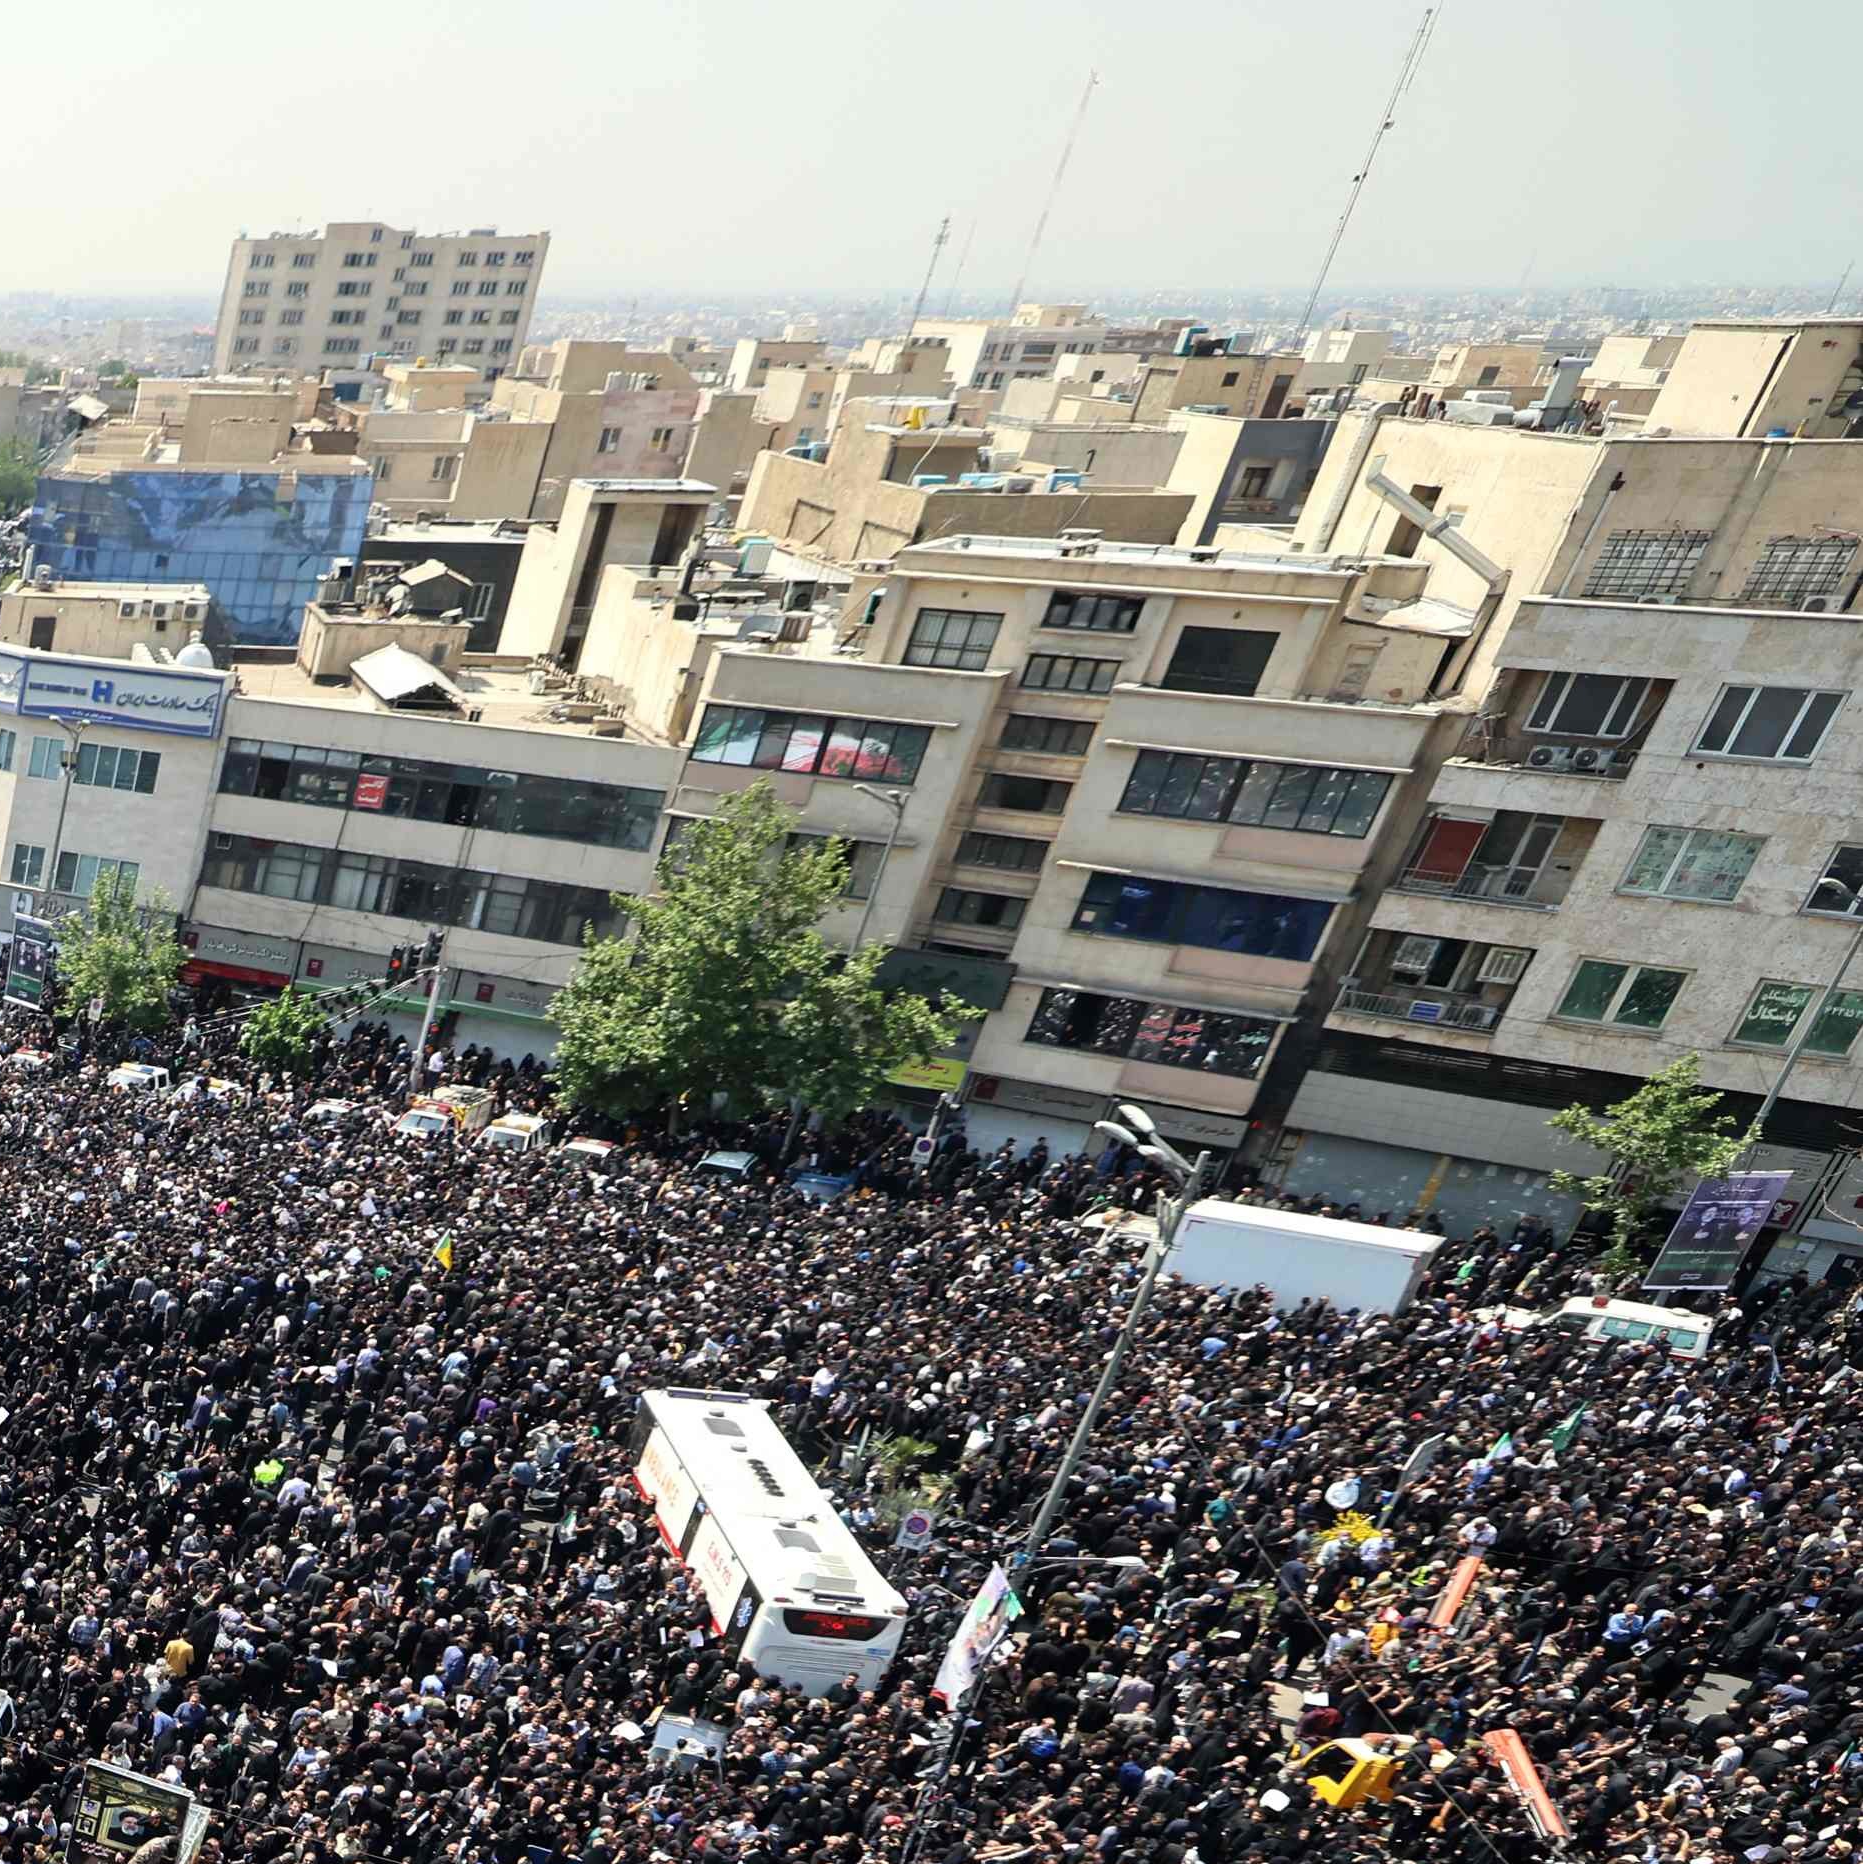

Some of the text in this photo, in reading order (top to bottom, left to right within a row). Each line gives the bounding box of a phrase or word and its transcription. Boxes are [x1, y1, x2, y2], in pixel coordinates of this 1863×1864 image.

[115, 691, 216, 718] بانک صادرات ایران
[1761, 989, 1807, 1007] آزمایشگاه
[1747, 1004, 1798, 1025] پاسکال
